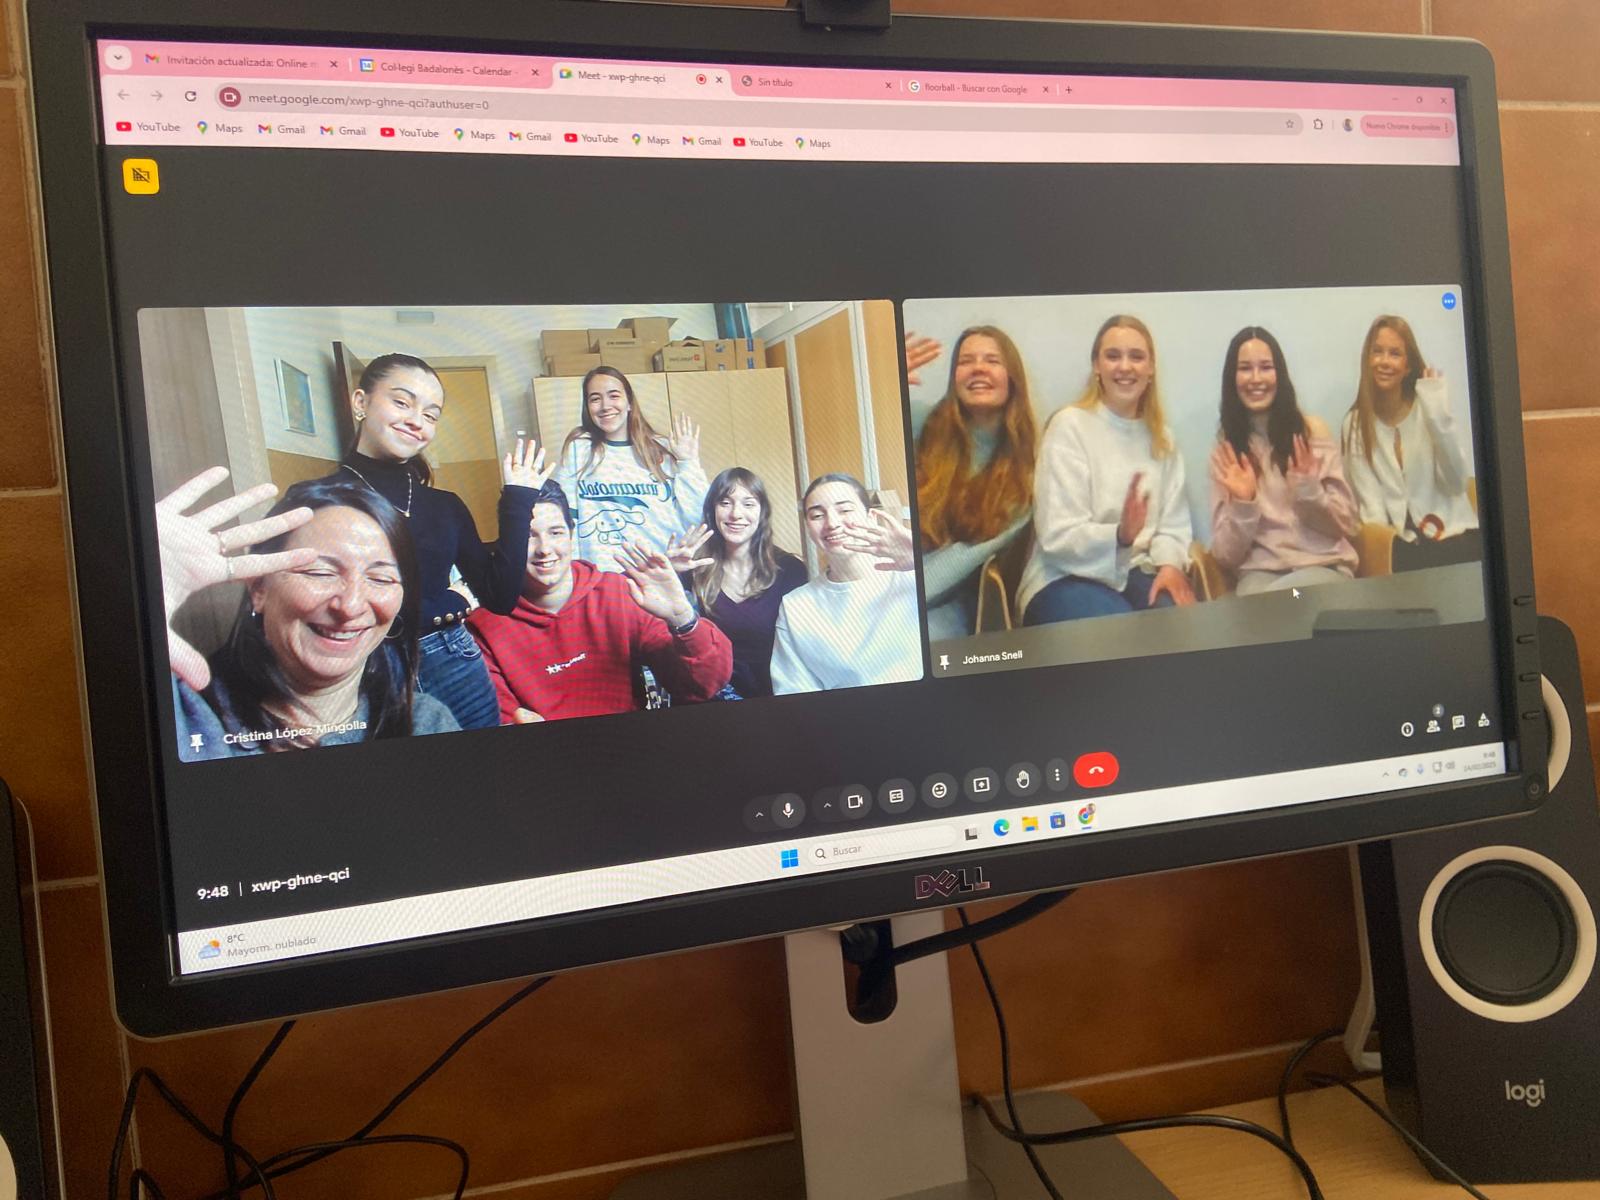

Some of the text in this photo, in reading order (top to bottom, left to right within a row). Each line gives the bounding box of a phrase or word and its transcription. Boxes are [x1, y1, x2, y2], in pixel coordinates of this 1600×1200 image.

[167, 55, 215, 66] Invitación
[217, 57, 273, 68] actualizada:
[276, 59, 308, 68] Online
[472, 66, 512, 76] Calendar
[578, 70, 601, 80] Meet
[608, 73, 666, 83] xwp-ghne-qci
[758, 78, 771, 87] Sin
[924, 83, 955, 92] floorball
[962, 84, 985, 93] Buscar
[1001, 85, 1027, 95] Google
[248, 93, 489, 110] meet.google.com/xwp-ghne-qci?authuser=0
[137, 122, 181, 132] YouTube
[215, 123, 243, 134] Maps
[277, 125, 305, 135] Gmail
[339, 127, 366, 136] Gmail
[399, 128, 439, 138] YouTube
[470, 131, 495, 141] Maps
[526, 132, 552, 142] Gmail
[581, 134, 618, 144] YouTube
[647, 135, 670, 146] Maps
[698, 137, 722, 146] Gmail
[749, 138, 783, 148] YouTube
[809, 139, 831, 149] Maps
[962, 650, 1023, 665] Johanna Snell
[223, 720, 367, 744] Cristina López Mingolla
[833, 845, 862, 857] Buscar
[251, 867, 350, 893] xwp-ghne-qci
[914, 866, 991, 899] DELL
[197, 886, 229, 900] 9:48
[226, 933, 245, 943] 8°C
[227, 936, 317, 957] Mayorm. nublado
[1505, 1078, 1546, 1108] logi
